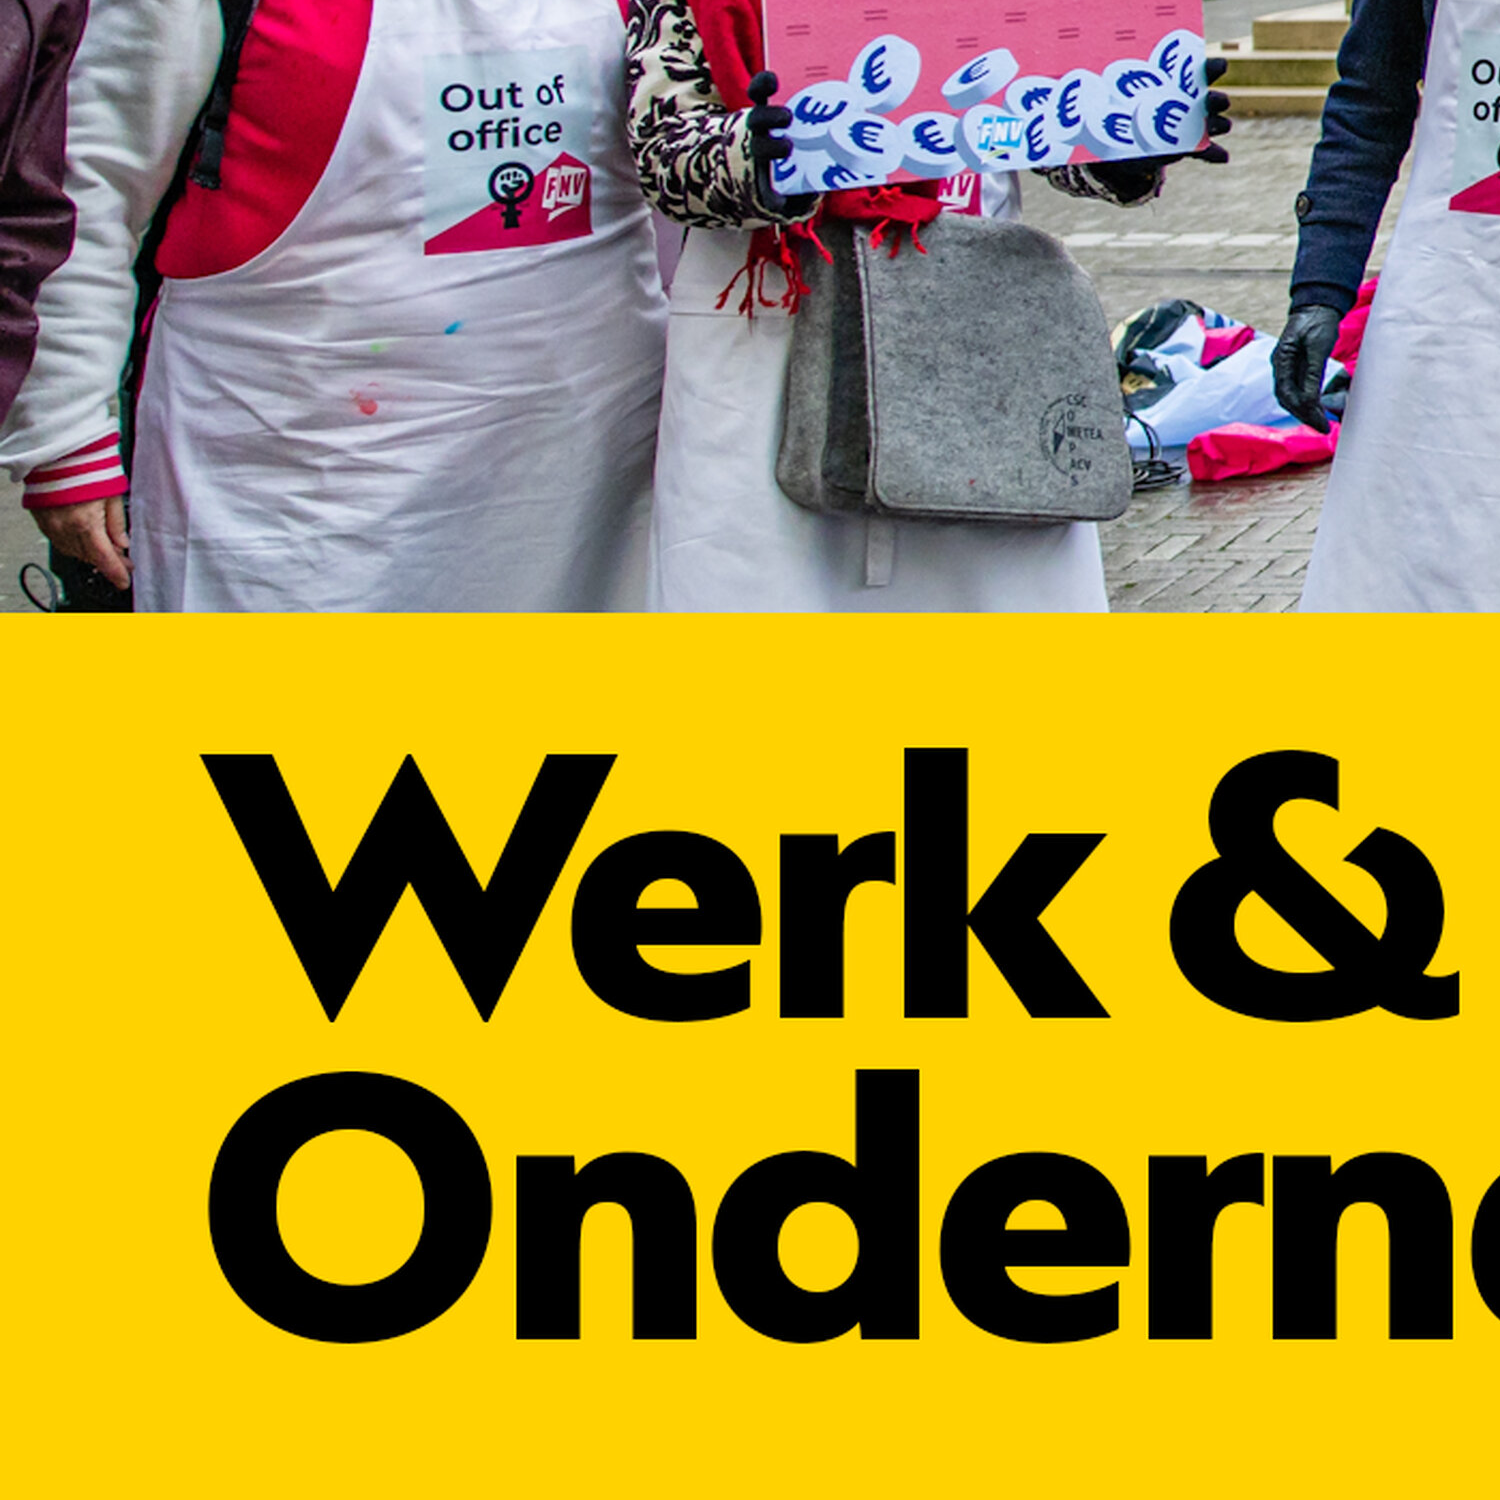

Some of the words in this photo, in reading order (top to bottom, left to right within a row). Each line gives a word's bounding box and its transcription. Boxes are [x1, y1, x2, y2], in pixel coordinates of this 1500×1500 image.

[440, 82, 524, 113] Out
[536, 74, 565, 106] of
[448, 117, 562, 152] office
[979, 119, 1024, 144] FNV
[545, 171, 586, 201] FNV
